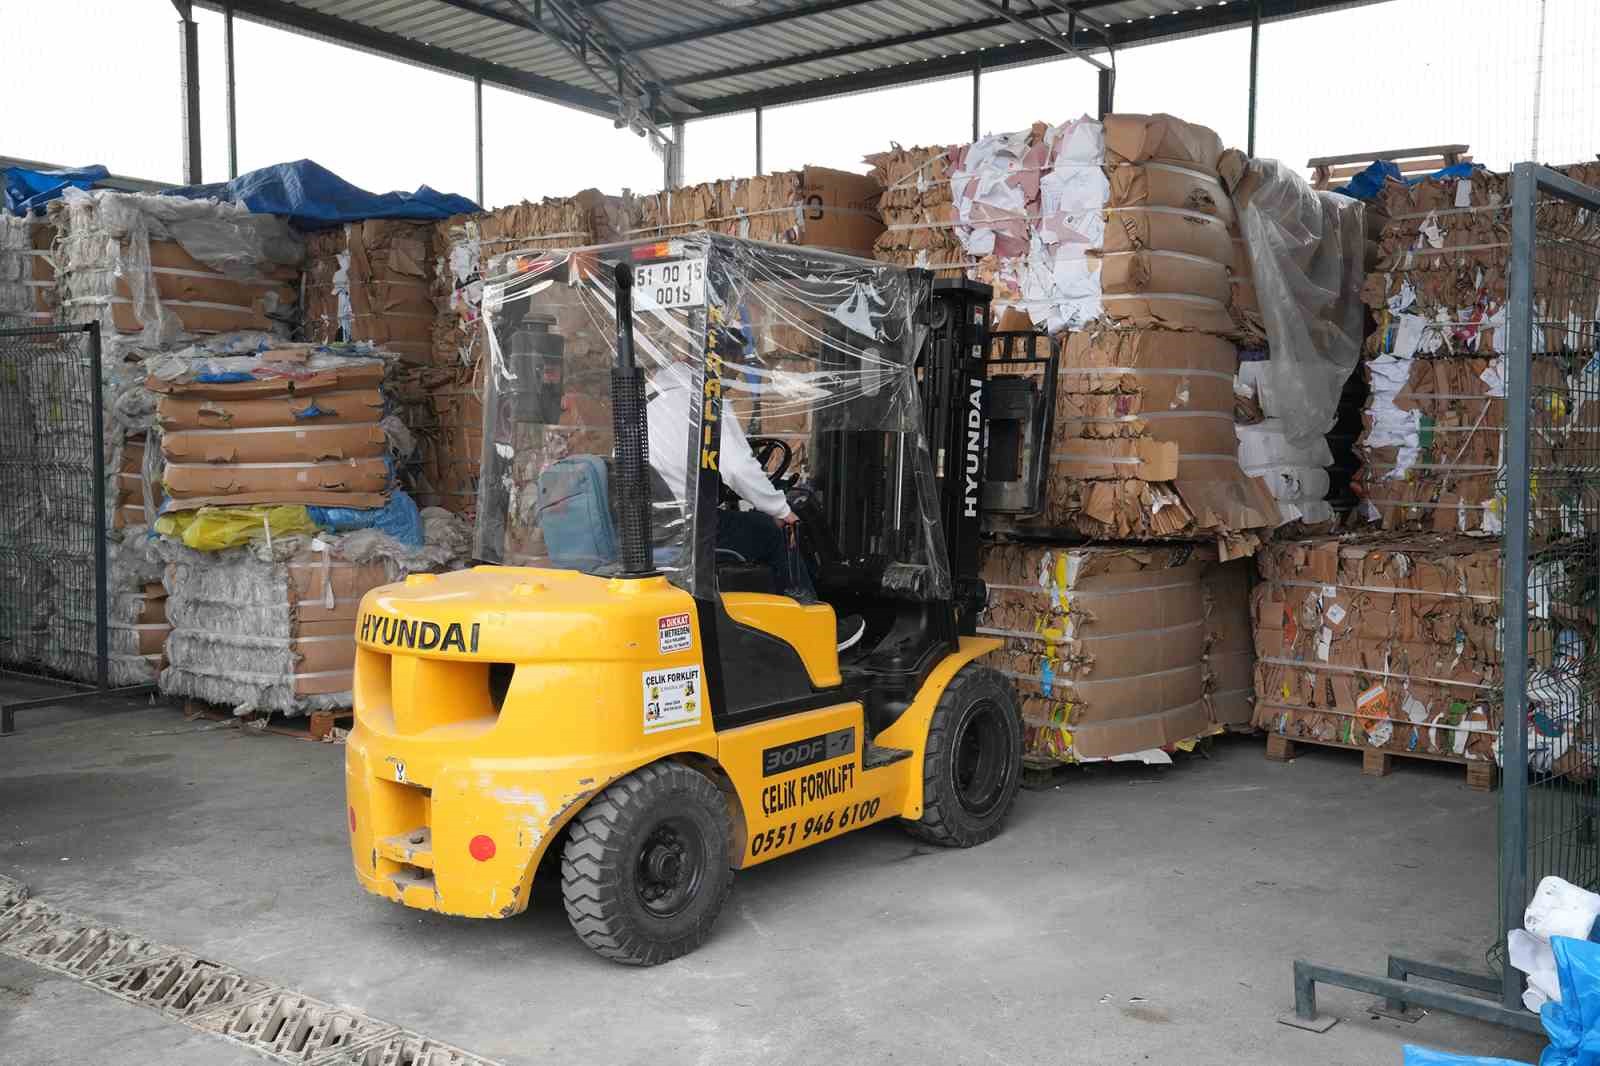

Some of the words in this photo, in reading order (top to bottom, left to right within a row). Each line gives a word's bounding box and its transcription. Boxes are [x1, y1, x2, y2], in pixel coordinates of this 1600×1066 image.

[964, 378, 983, 518] HYUNDAI
[361, 613, 480, 653] HYUNDAI
[751, 822, 797, 857] 0551
[802, 811, 835, 841] 946
[839, 797, 881, 828] 6100
